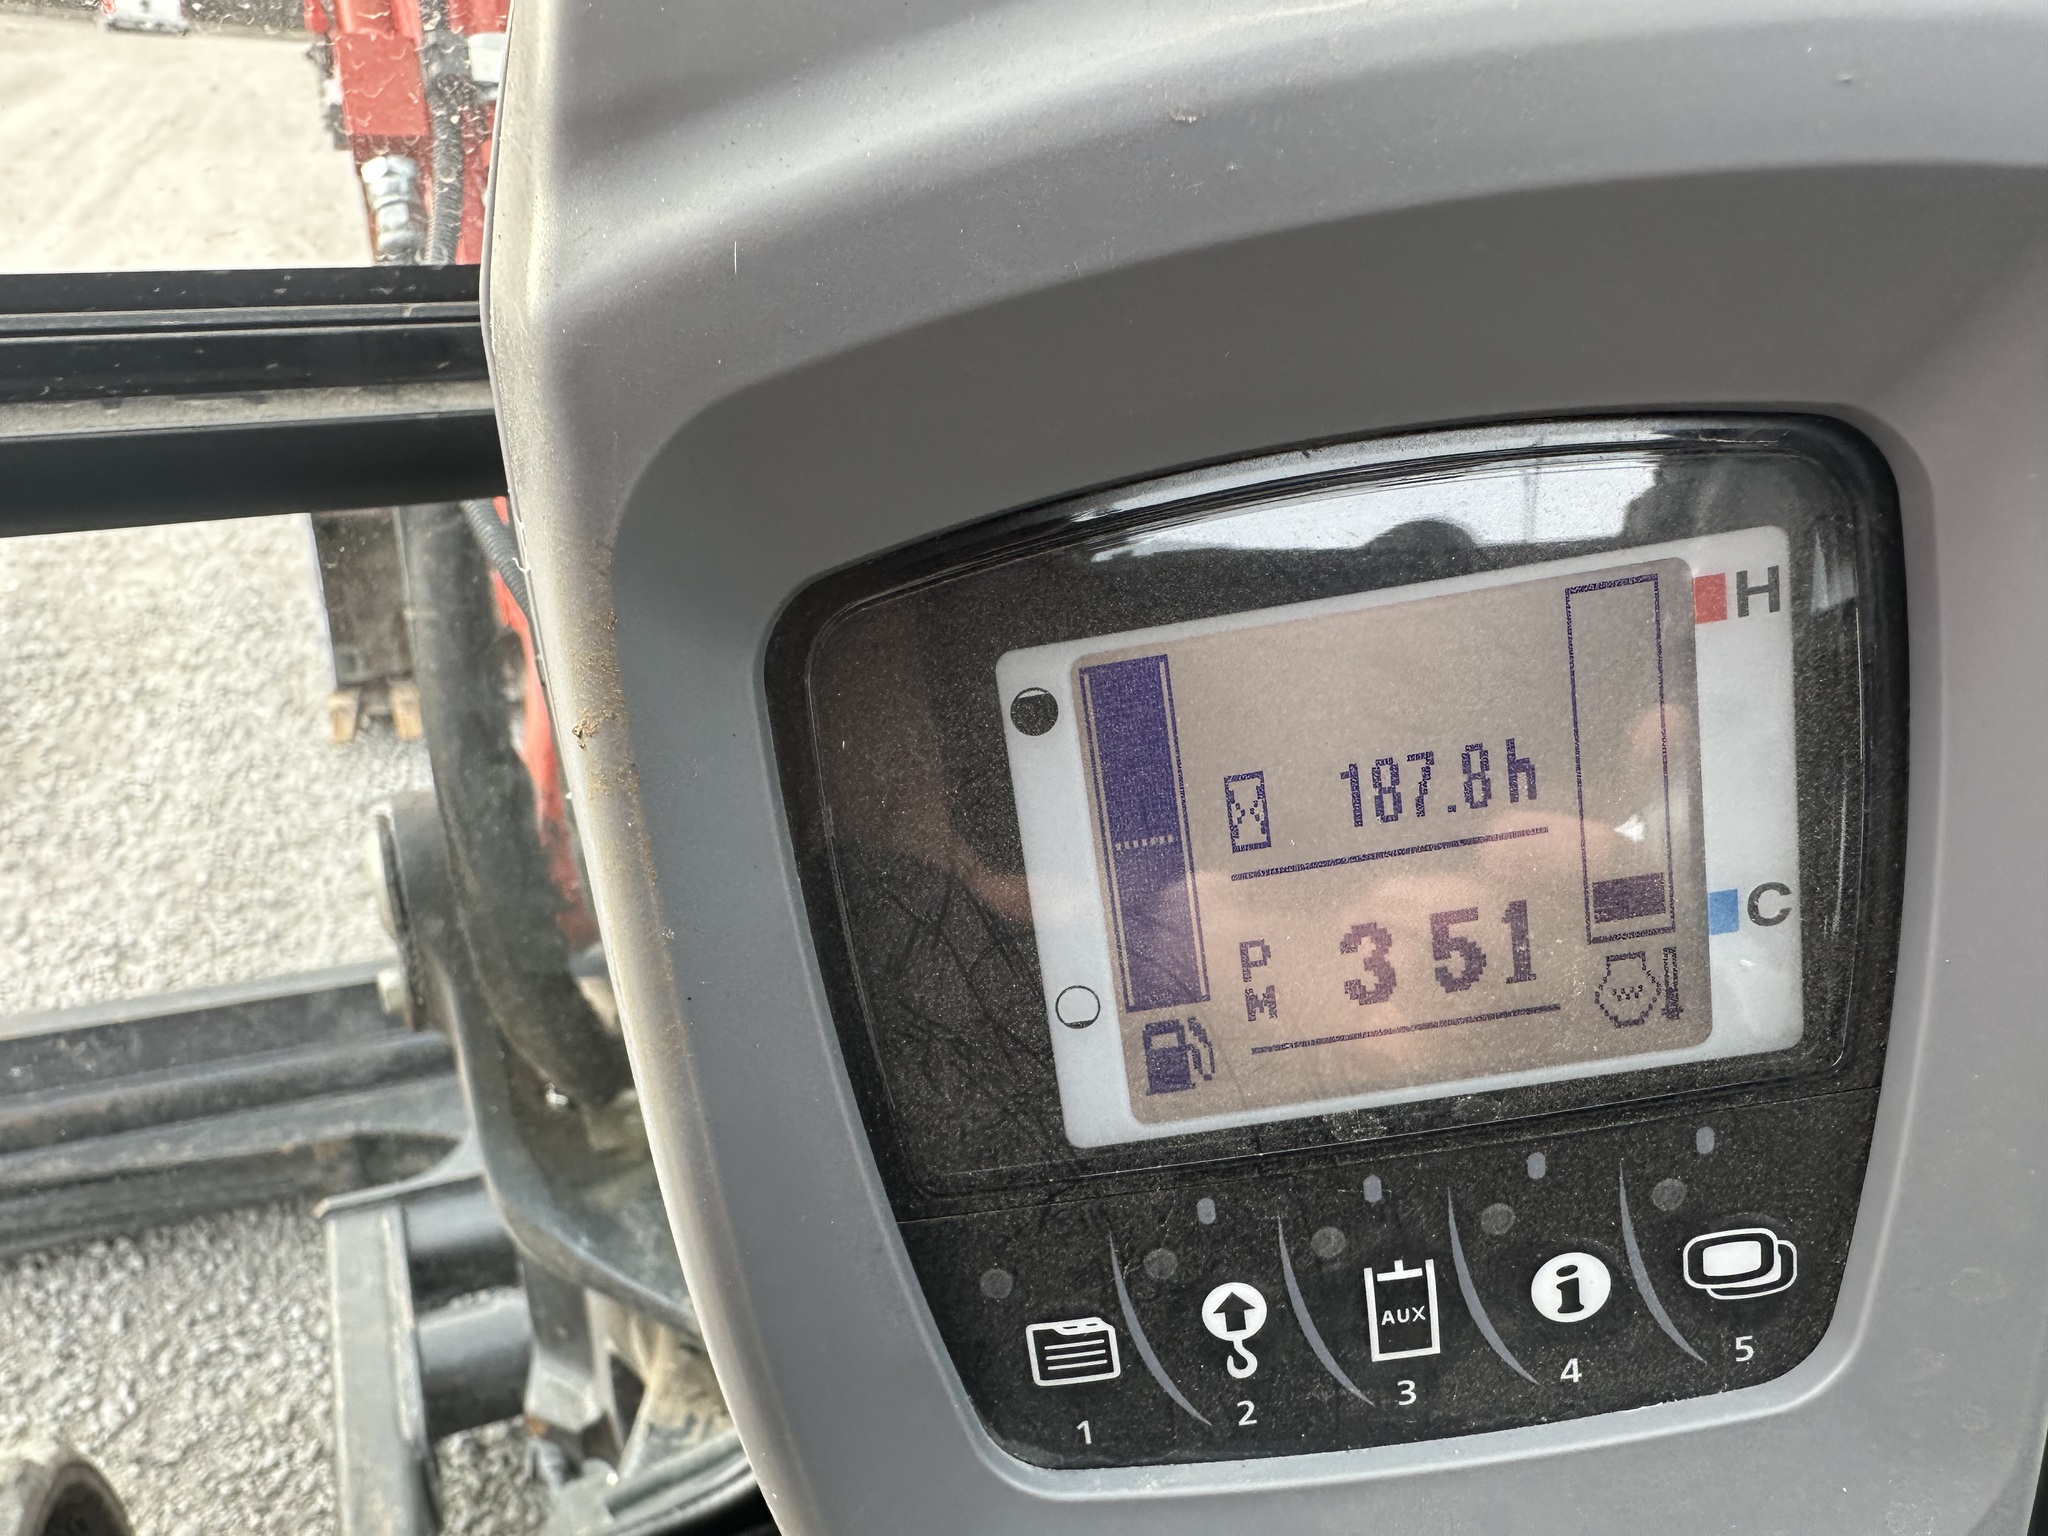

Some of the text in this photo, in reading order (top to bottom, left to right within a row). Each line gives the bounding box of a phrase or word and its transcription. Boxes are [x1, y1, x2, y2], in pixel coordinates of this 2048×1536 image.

[1736, 565, 1780, 618] H
[1747, 881, 1793, 927] C
[1381, 1305, 1427, 1326] AUX
[1735, 1335, 1755, 1362] 5
[1560, 1357, 1583, 1383] 4
[1397, 1380, 1417, 1406] 3
[1237, 1400, 1258, 1426] 2
[1076, 1420, 1092, 1445] 1
